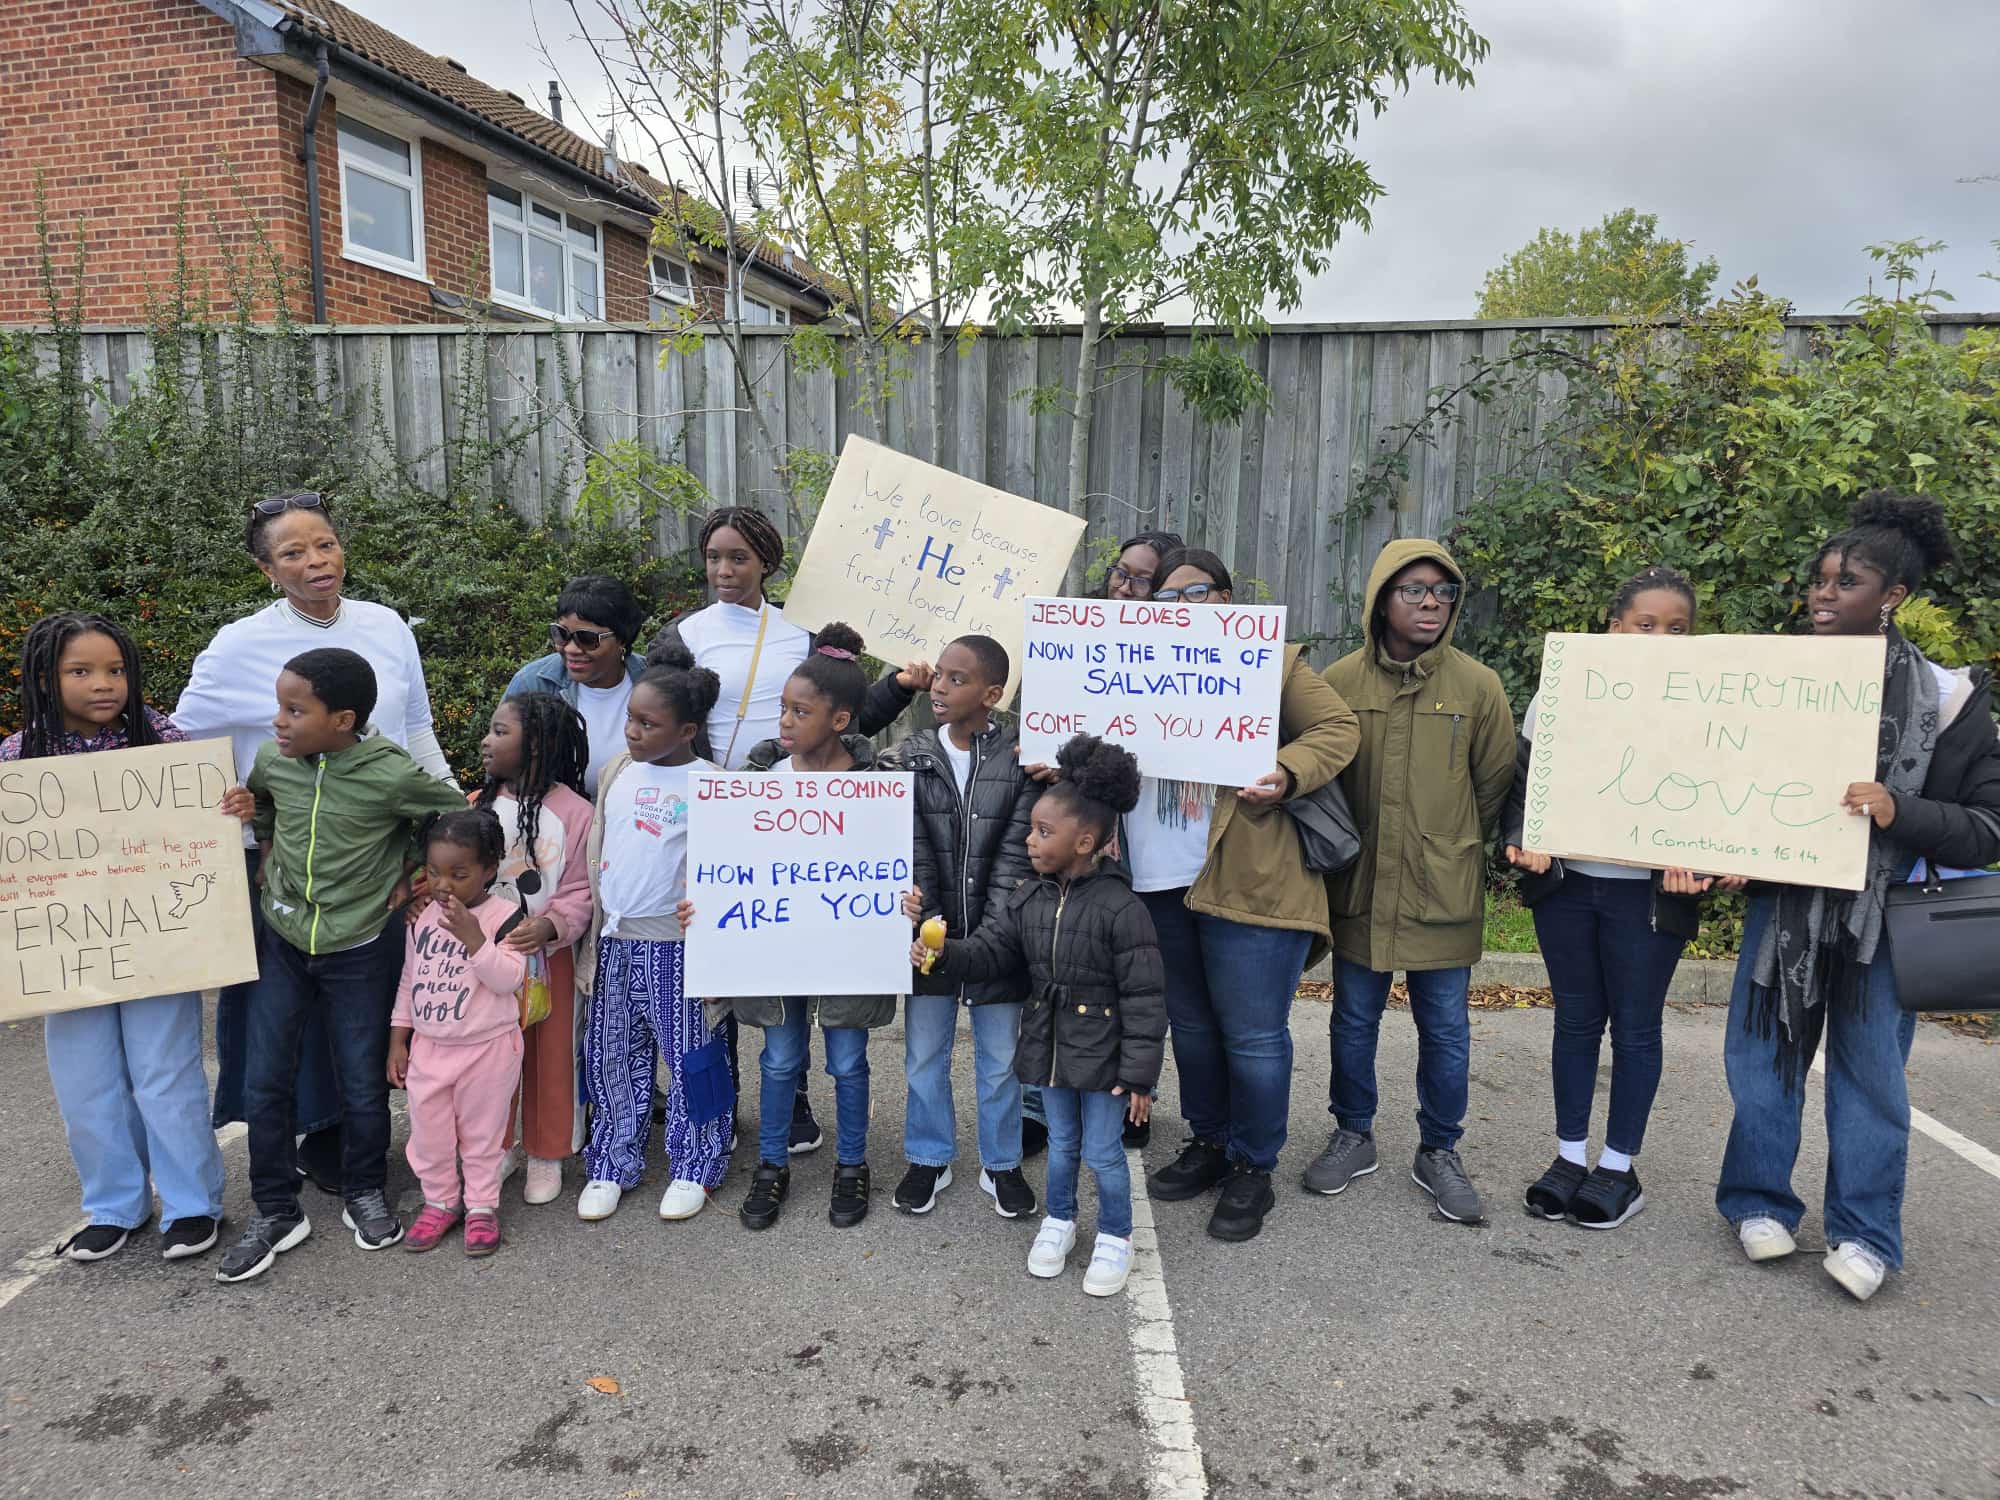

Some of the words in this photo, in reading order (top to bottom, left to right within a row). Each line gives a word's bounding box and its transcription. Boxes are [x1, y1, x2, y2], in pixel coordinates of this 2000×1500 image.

[864, 471, 904, 507] We
[919, 494, 962, 533] love
[971, 512, 1039, 563] because
[917, 535, 966, 586] He
[846, 553, 895, 595] first
[908, 577, 965, 624] loved
[968, 616, 992, 636] us
[880, 613, 928, 650] John
[1032, 604, 1105, 628] JESUS
[1119, 605, 1191, 628] LOVES
[1214, 610, 1280, 641] YOU
[1028, 641, 1073, 661] NOW
[1086, 643, 1107, 664] IS
[1116, 643, 1155, 664] THE
[1171, 645, 1222, 665] TIME
[1240, 649, 1273, 669] OF
[1084, 669, 1241, 696] SALVATION
[1664, 671, 1881, 714] EVERYTHING
[1026, 711, 1087, 735] COME
[1105, 714, 1137, 736] AS
[1154, 713, 1203, 741] YOU
[1215, 715, 1273, 742] ARE
[1705, 721, 1748, 751] IN
[0, 771, 66, 824] SO
[93, 762, 228, 813] LOVED
[698, 778, 783, 800] JESUS
[796, 781, 818, 798] IS
[827, 778, 907, 799] COMING
[753, 809, 844, 835] SOON
[1630, 825, 1638, 845] 1
[0, 828, 100, 864] ORLD
[121, 838, 151, 856] that
[161, 836, 183, 854] he
[188, 840, 217, 859] gave
[26, 872, 69, 886] everyone
[76, 868, 98, 877] who
[107, 863, 146, 874] believes
[159, 861, 171, 870] in
[180, 858, 202, 869] him
[697, 863, 754, 885] HOW
[772, 858, 908, 887] PREPARED
[28, 887, 57, 899] have
[717, 898, 790, 930] ARE
[19, 943, 136, 995] LIFE
[418, 962, 430, 976] is
[438, 959, 467, 978] the
[412, 982, 470, 1022] Cool
[427, 980, 462, 994] new
